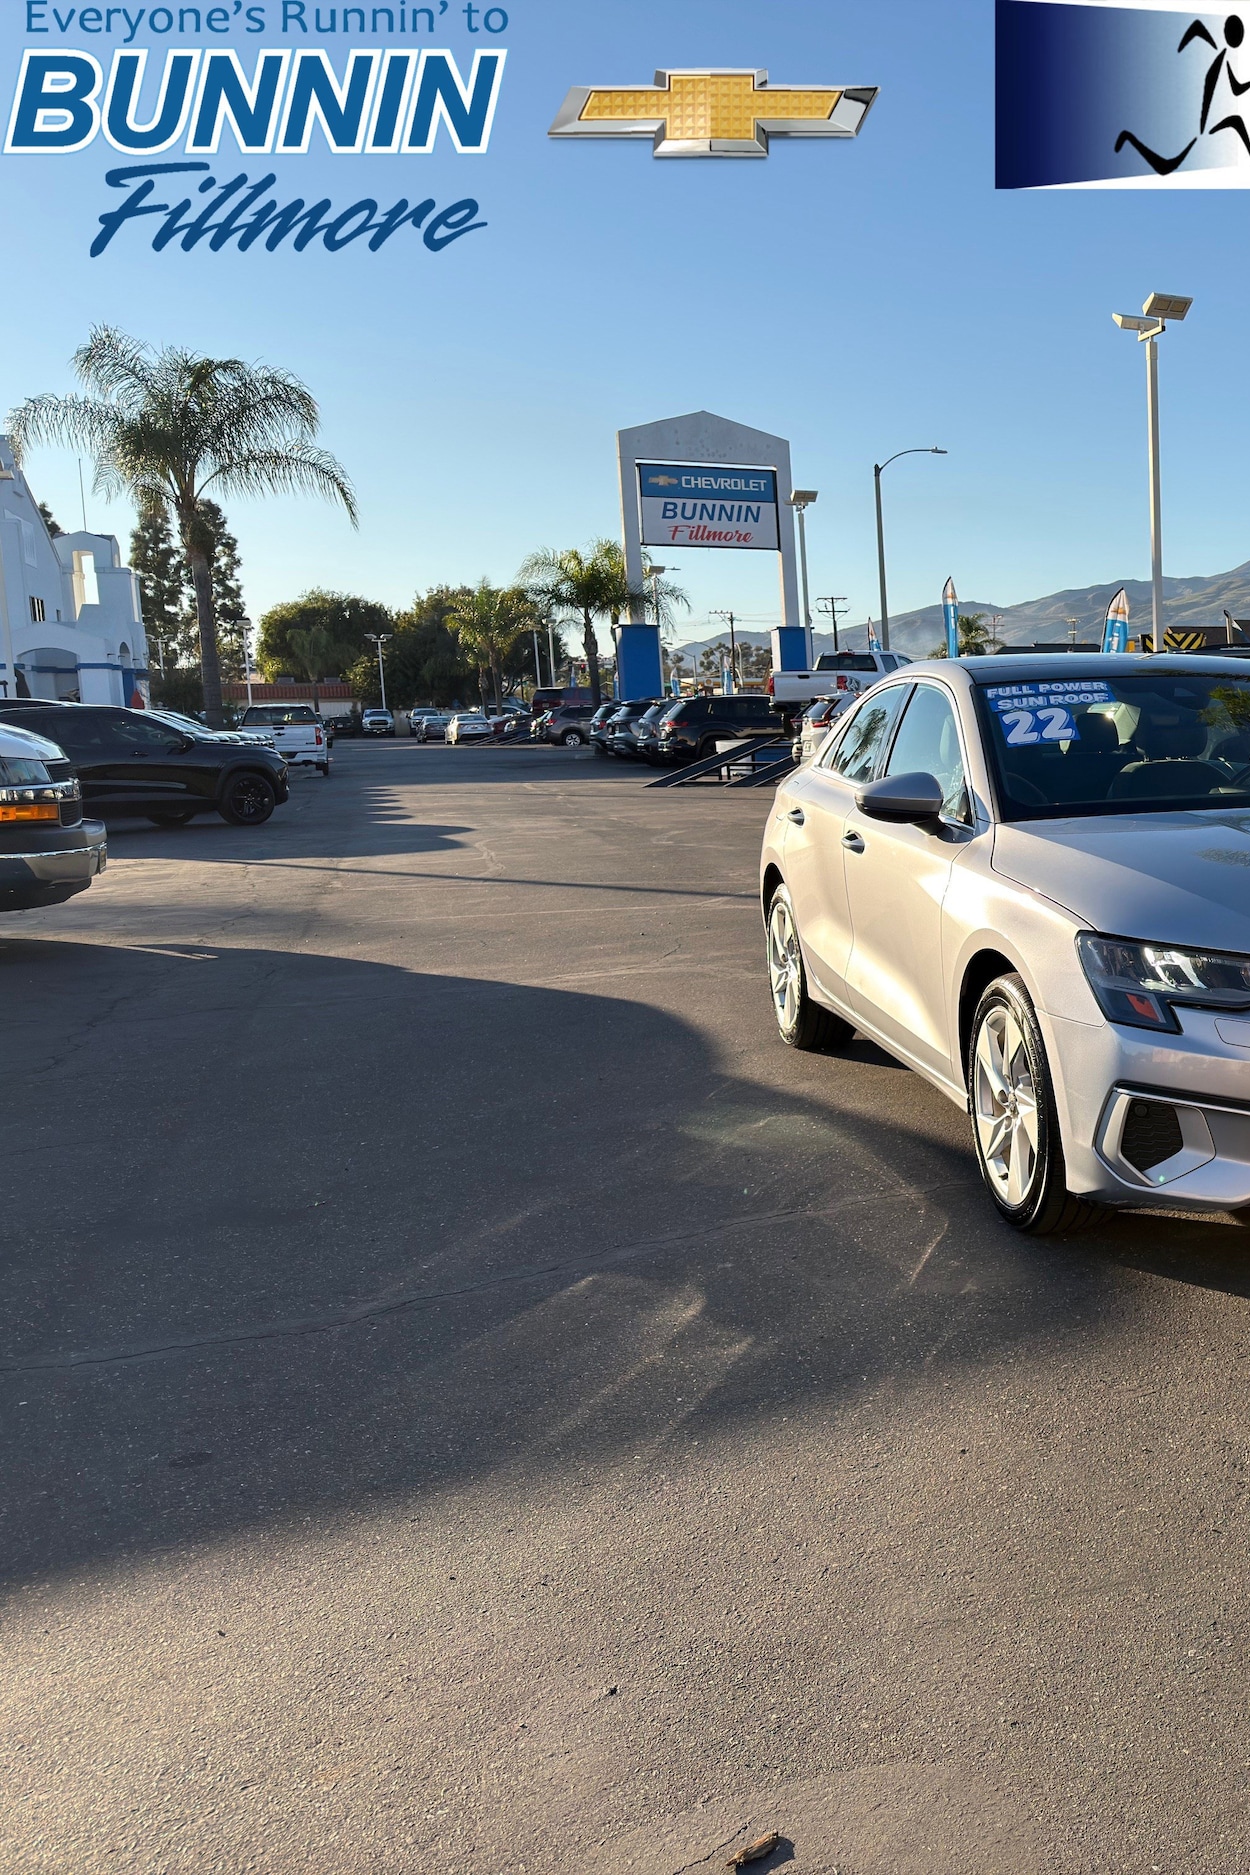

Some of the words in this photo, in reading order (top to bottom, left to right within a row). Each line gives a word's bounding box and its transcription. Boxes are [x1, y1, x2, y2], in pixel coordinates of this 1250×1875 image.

[681, 476, 767, 491] CHEVROLET
[661, 501, 761, 523] BUNNIN
[667, 525, 754, 543] Fillmore
[987, 685, 1035, 698] FULL
[1039, 682, 1108, 693] POWER
[998, 696, 1047, 709] SUN
[1049, 693, 1109, 704] ROOF
[1002, 708, 1075, 744] 22
